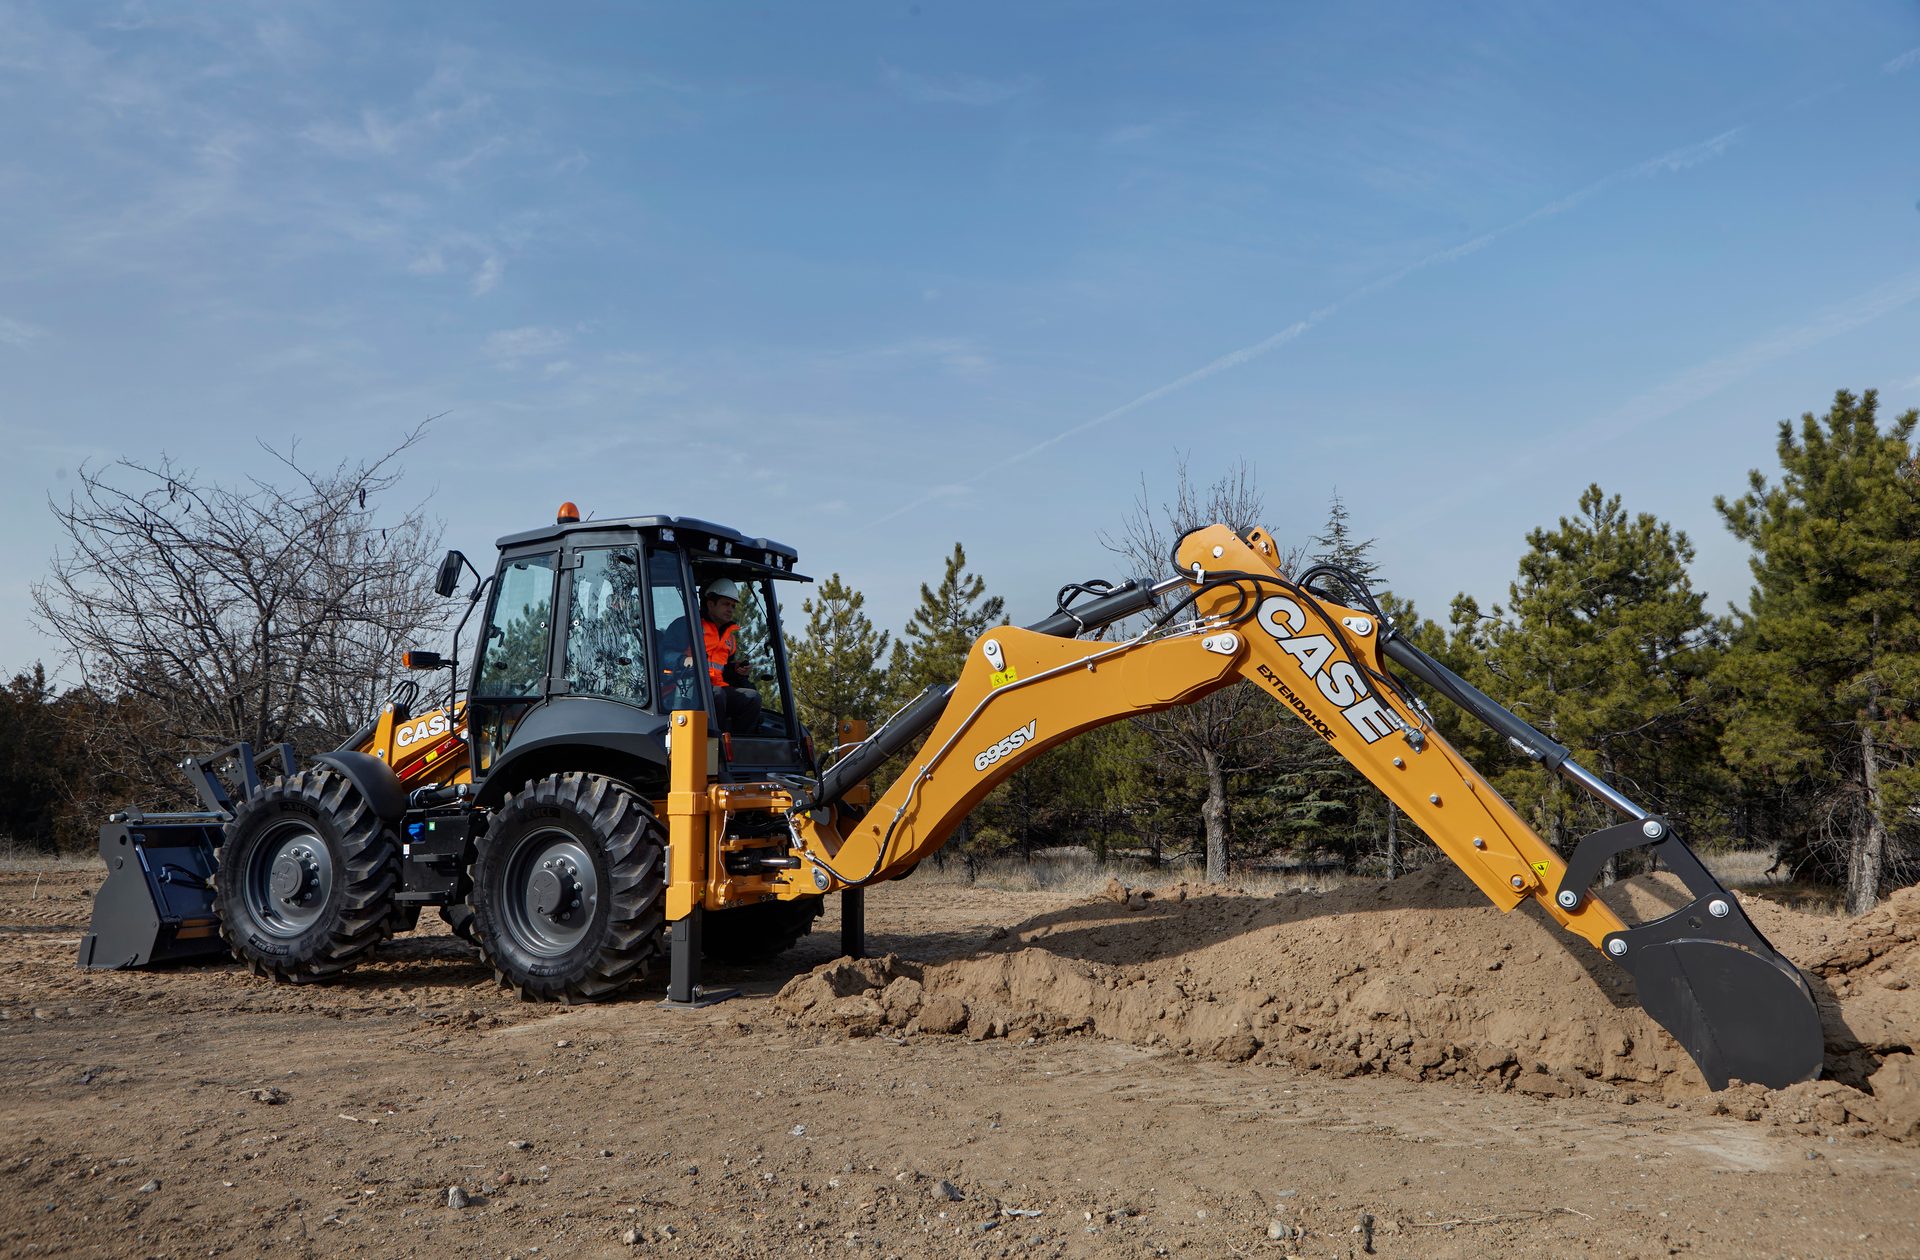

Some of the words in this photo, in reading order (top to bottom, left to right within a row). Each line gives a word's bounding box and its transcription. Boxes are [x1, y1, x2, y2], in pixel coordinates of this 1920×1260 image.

[1256, 595, 1399, 745] CASE
[1256, 664, 1337, 742] EXTENDAHOE
[974, 718, 1037, 771] 695SV
